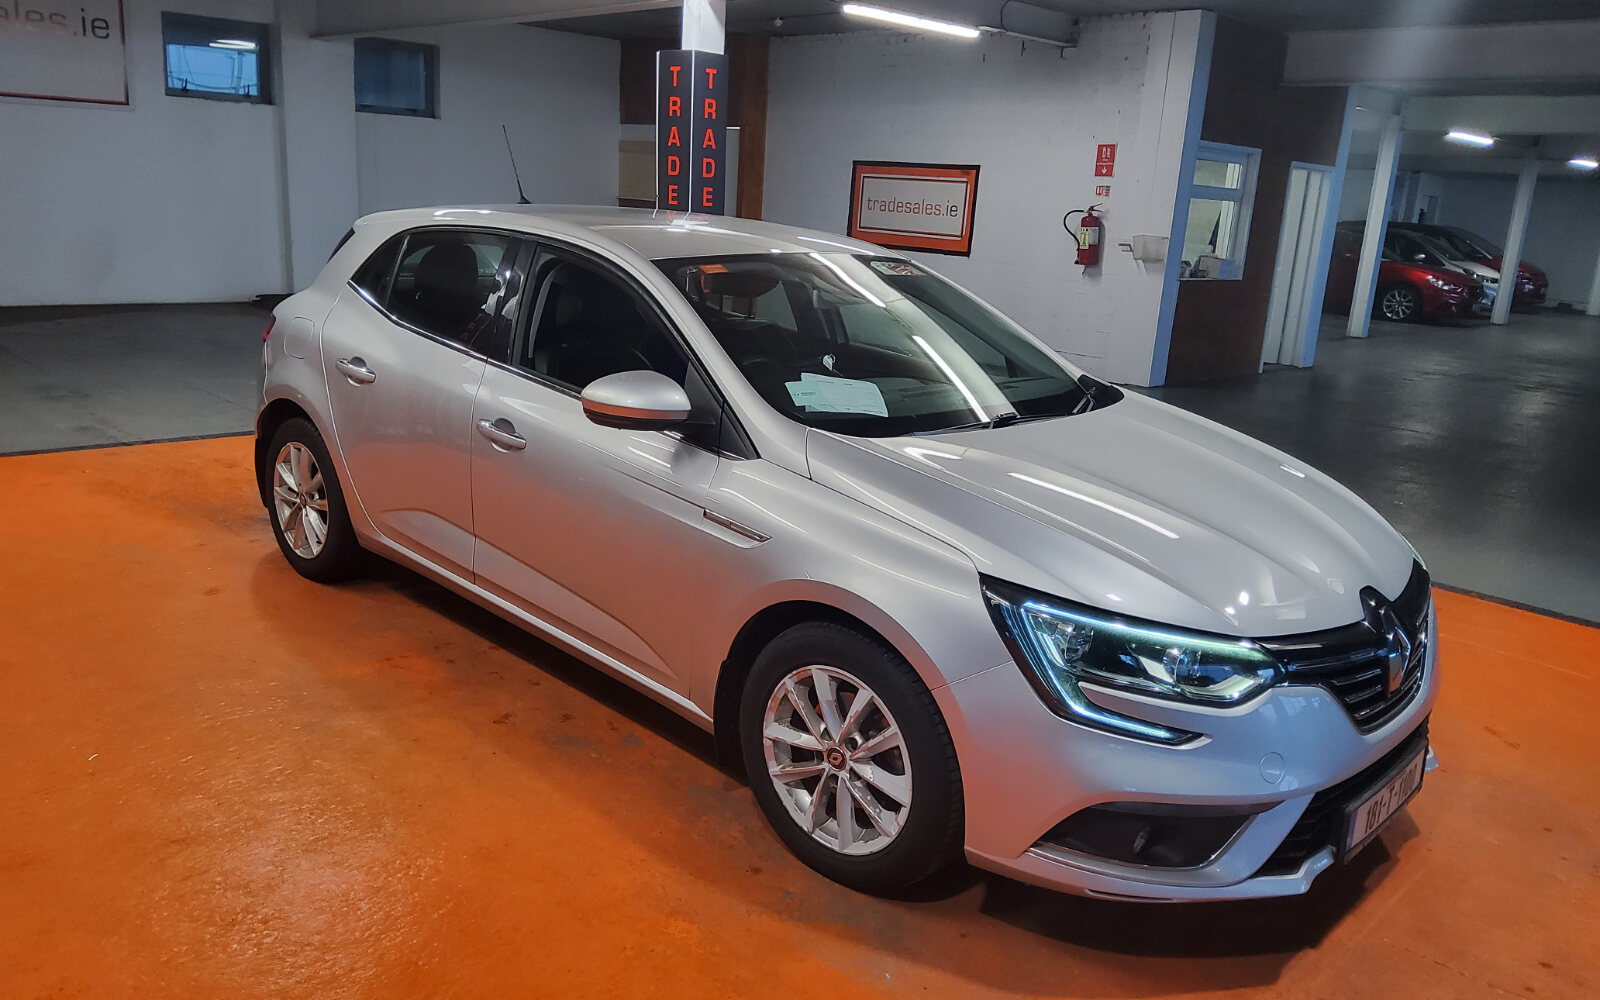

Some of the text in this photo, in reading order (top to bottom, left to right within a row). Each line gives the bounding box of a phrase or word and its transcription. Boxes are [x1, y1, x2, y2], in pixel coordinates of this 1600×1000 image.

[667, 66, 681, 205] TRADE
[702, 68, 717, 207] TRADE
[867, 197, 958, 218] tradesales.ie
